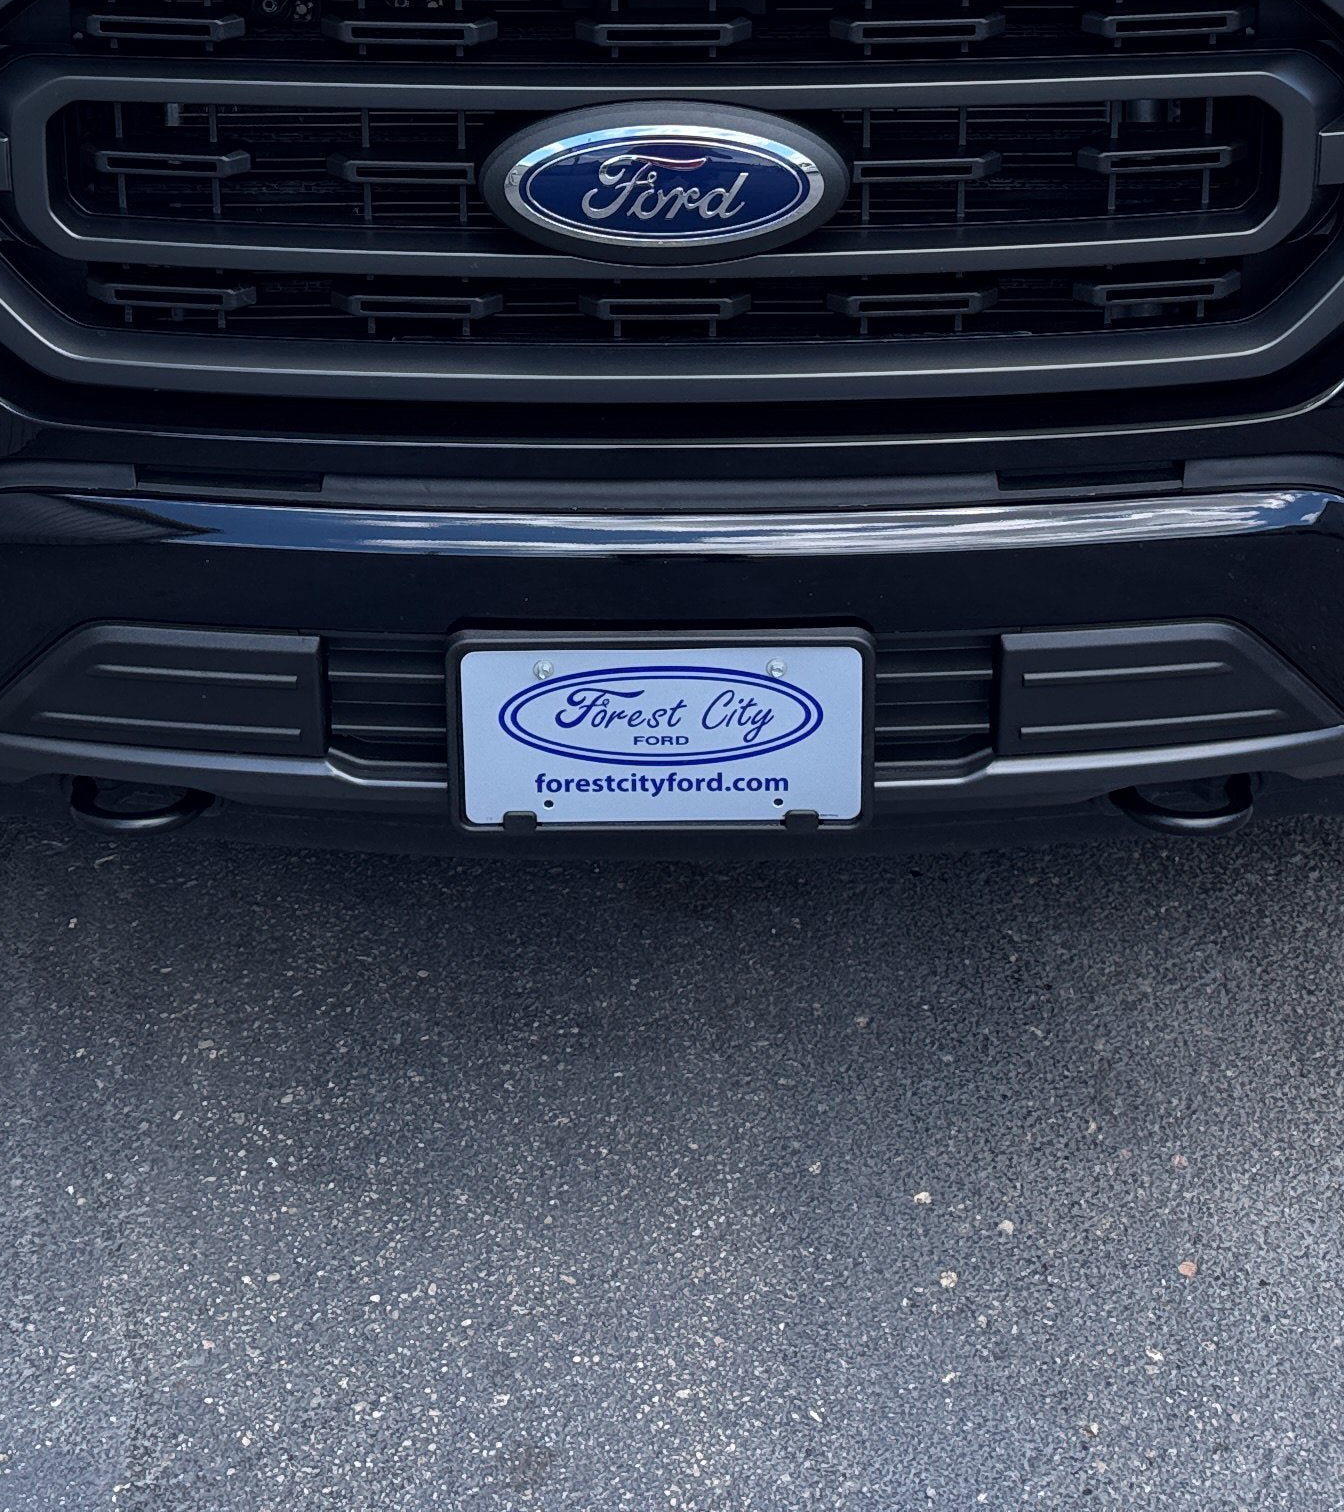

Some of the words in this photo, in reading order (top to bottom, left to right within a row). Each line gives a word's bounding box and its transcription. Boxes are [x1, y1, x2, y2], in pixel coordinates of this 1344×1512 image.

[581, 154, 749, 220] Ford
[555, 688, 687, 729] Forest
[702, 690, 775, 743] City
[633, 735, 690, 746] FORD
[534, 772, 790, 798] forestcityford.com
